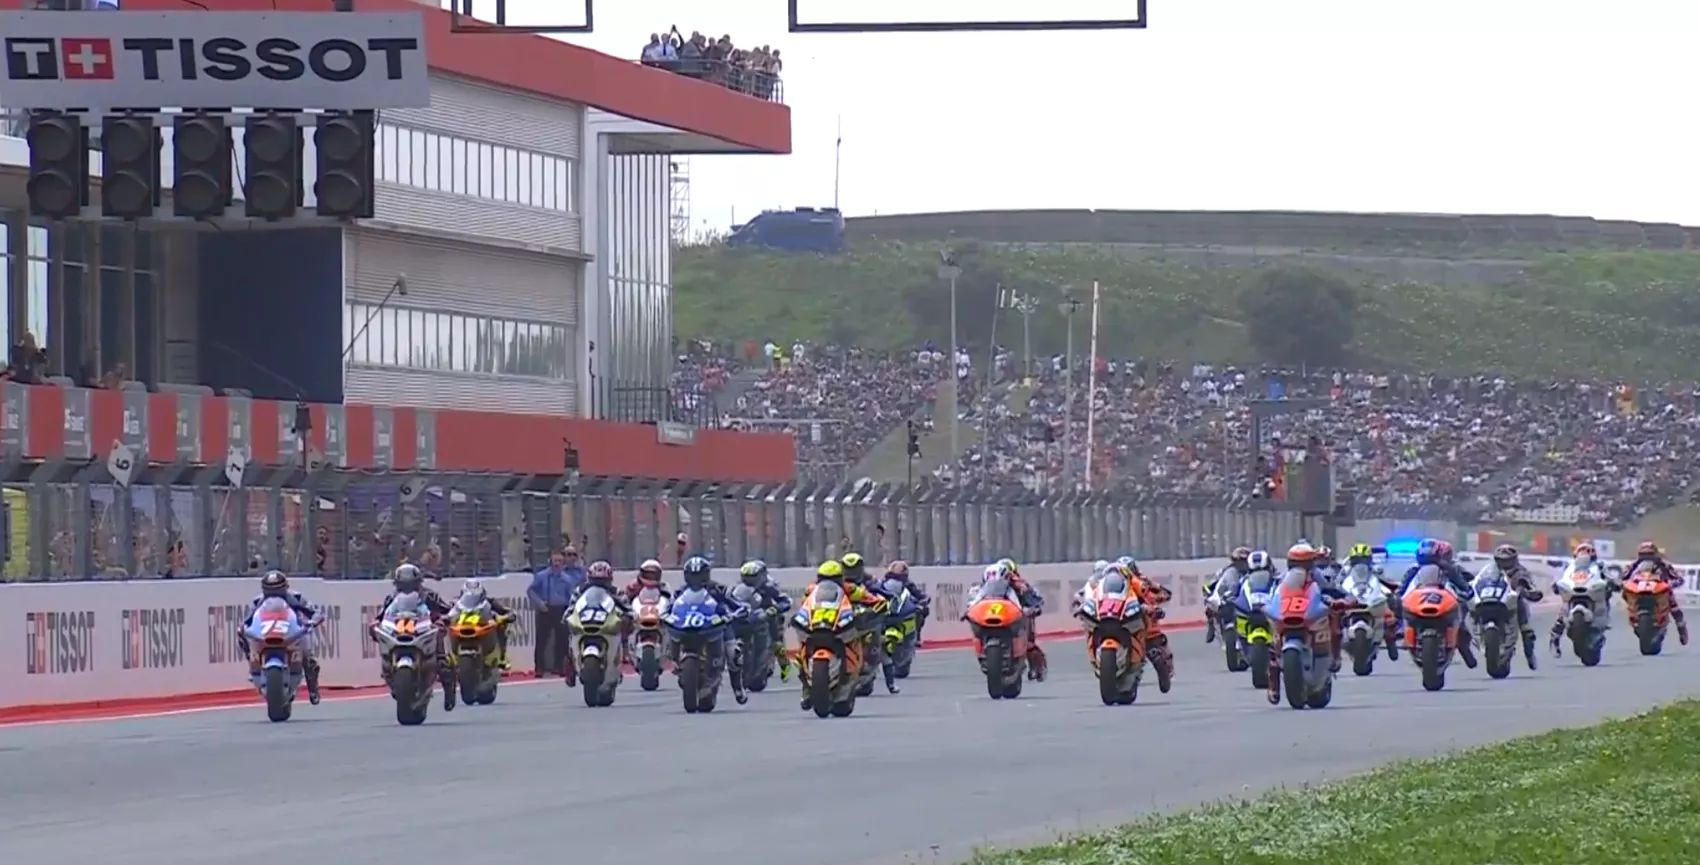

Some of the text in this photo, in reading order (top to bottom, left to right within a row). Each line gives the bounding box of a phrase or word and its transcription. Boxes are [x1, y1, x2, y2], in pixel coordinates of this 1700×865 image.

[123, 37, 418, 82] TISSOT
[260, 619, 290, 635] 75
[682, 610, 705, 628] 16
[812, 608, 837, 624] 54
[47, 611, 95, 674] TISSOT
[140, 608, 185, 669] TISSOT
